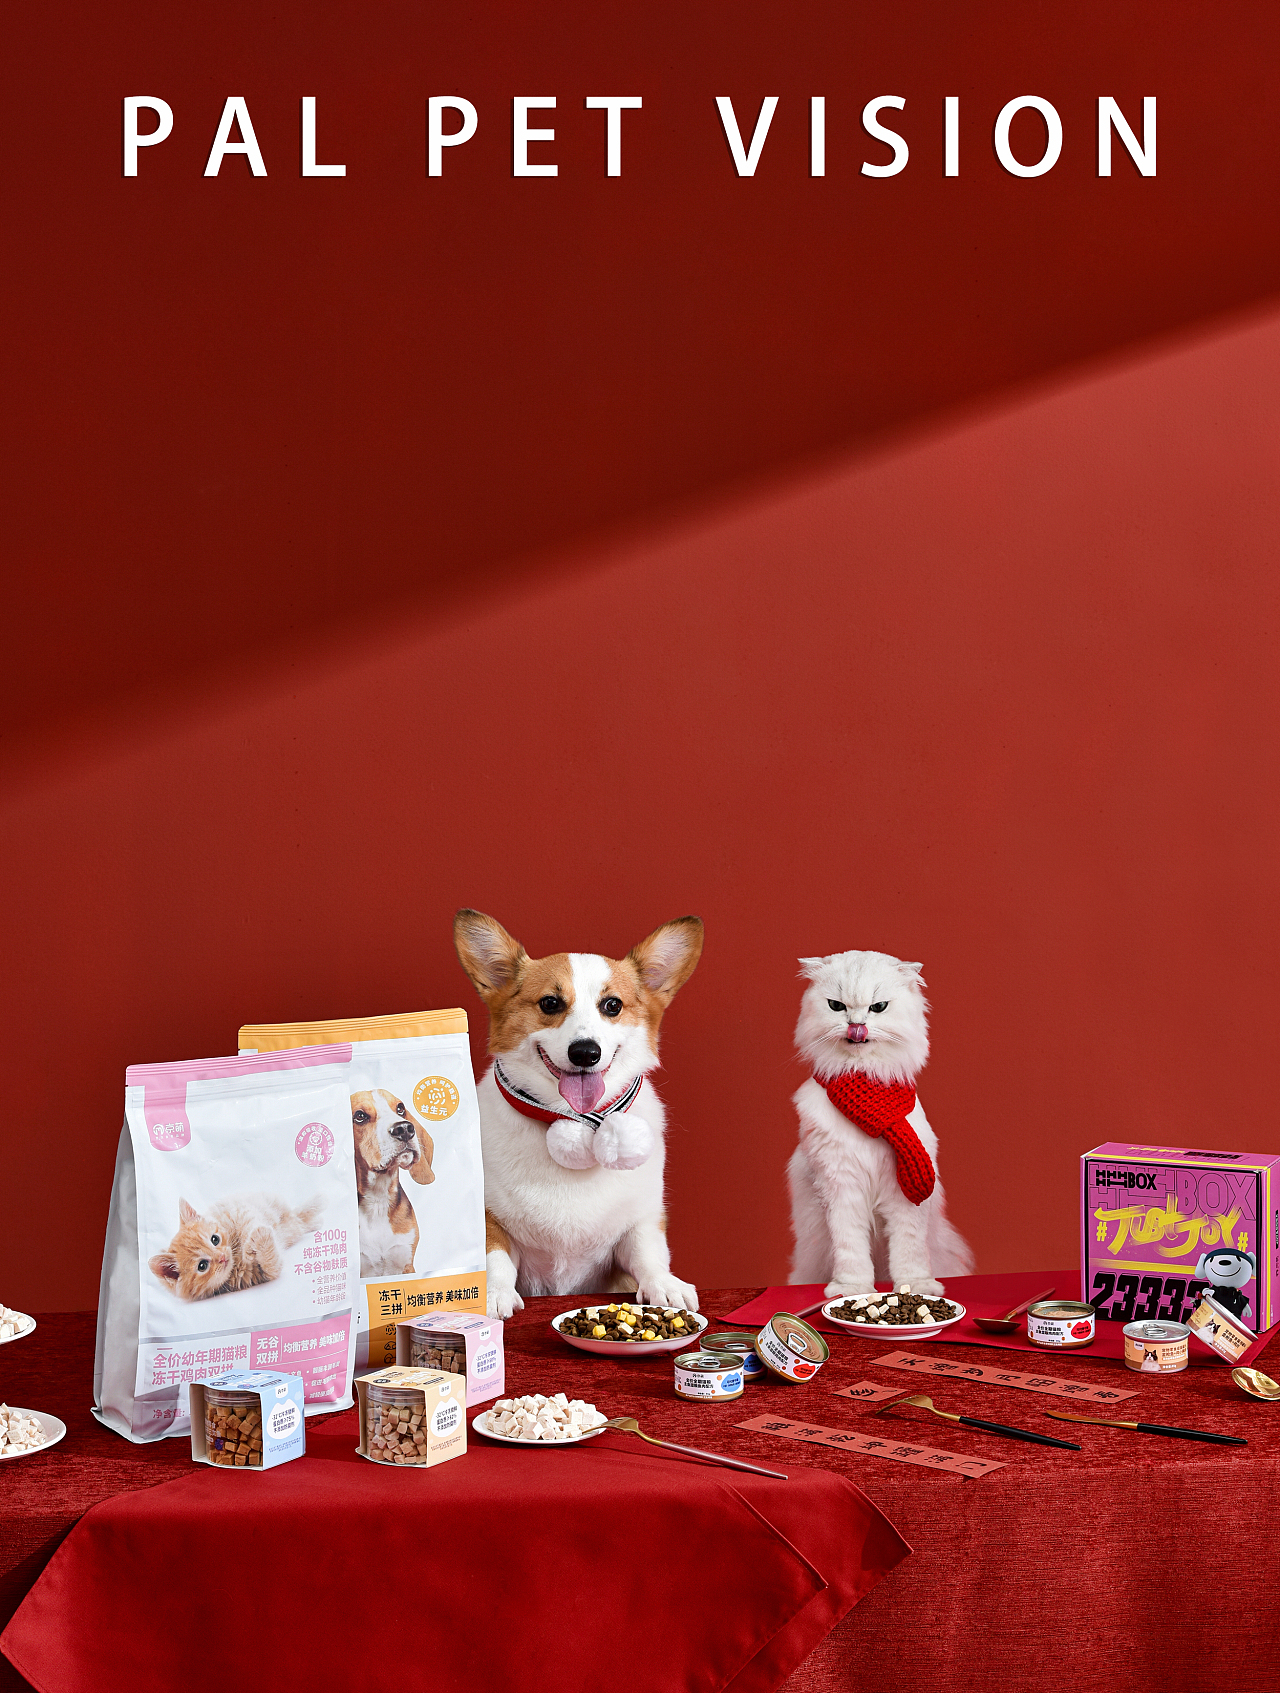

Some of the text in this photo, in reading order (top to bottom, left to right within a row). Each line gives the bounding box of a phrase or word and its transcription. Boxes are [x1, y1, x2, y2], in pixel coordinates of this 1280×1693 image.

[420, 1104, 448, 1116] 益生元
[313, 1228, 347, 1244] 含100g
[303, 1242, 347, 1259] 纯冻干鸡肉
[294, 1256, 348, 1276] 不含谷物麸质
[378, 1288, 402, 1302] 冻干
[406, 1285, 479, 1308] 均衡营养 美味加倍
[380, 1302, 403, 1316] 三拼
[256, 1335, 279, 1351] 无谷
[283, 1329, 346, 1354] 均衡营养 美味加倍
[152, 1344, 248, 1369] 全价幼年期猫粮
[256, 1350, 279, 1366] 双拼
[151, 1363, 234, 1386] 冻干鸡肉双拼
